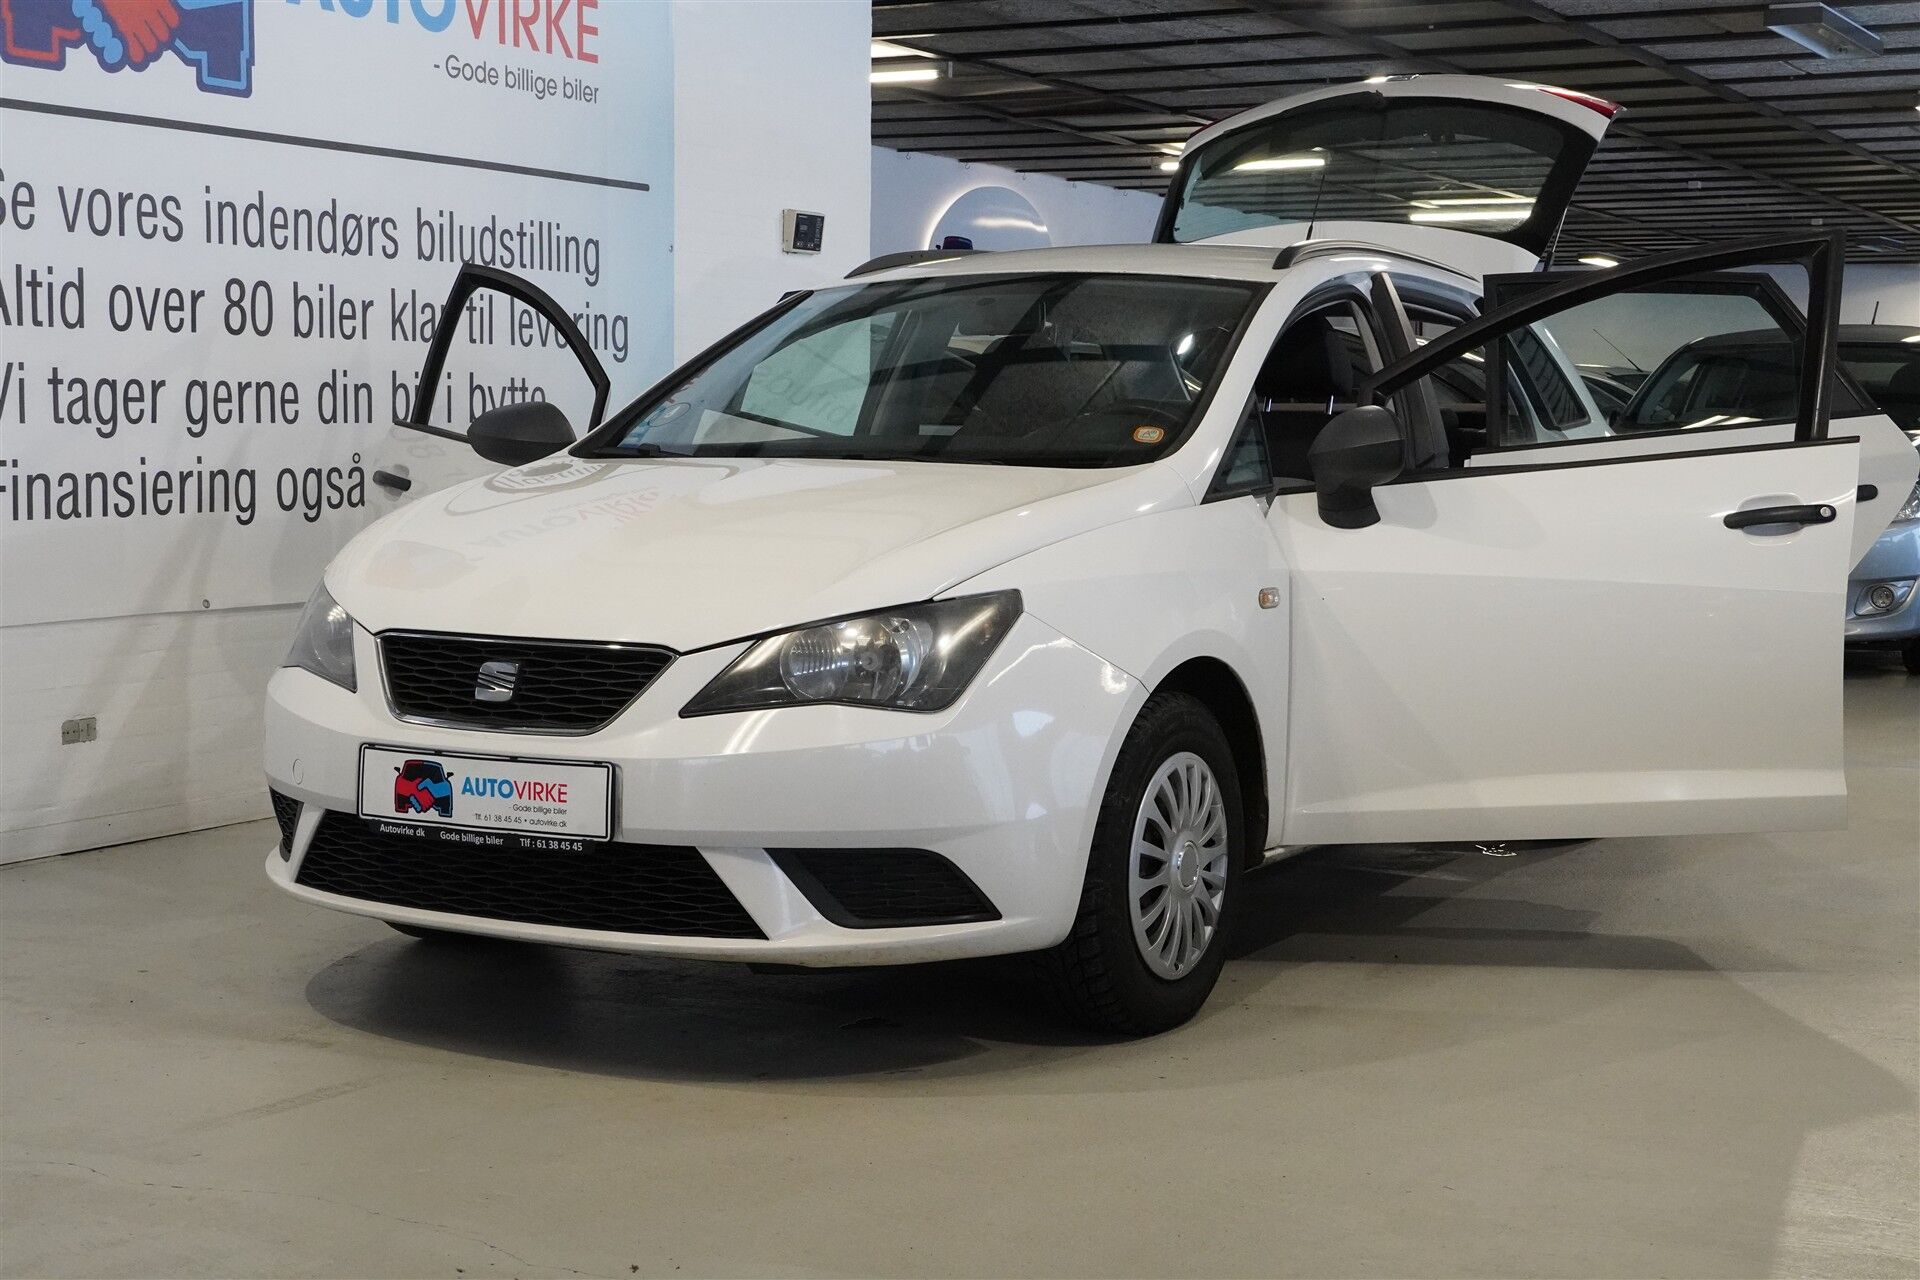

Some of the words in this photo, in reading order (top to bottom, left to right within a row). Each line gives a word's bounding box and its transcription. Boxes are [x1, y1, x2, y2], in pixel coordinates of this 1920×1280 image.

[286, 0, 598, 64] VIRKE
[445, 54, 499, 86] Gode
[504, 68, 558, 100] billige
[562, 76, 599, 105] biler
[57, 185, 184, 242] vores
[205, 185, 399, 260] indendørs
[417, 206, 600, 287] biludstilling
[108, 284, 206, 334] over
[223, 277, 273, 337] 80
[293, 281, 374, 340] biler
[391, 288, 445, 343] kla
[466, 296, 493, 345] til
[47, 367, 166, 439] tager
[185, 379, 300, 439] gerne
[318, 369, 373, 424] din
[447, 372, 452, 423] i
[276, 452, 366, 523] også
[461, 776, 568, 804] AUTOVIRKE
[512, 803, 532, 813] Gode
[533, 805, 552, 816] billige
[553, 807, 568, 816] biler
[440, 830, 460, 842] Gode
[462, 832, 484, 846] billige
[485, 834, 504, 846] biler
[484, 814, 492, 822] 61
[494, 814, 503, 823] 38
[504, 815, 512, 824] 45
[513, 816, 522, 825] 45
[536, 839, 547, 849] 61
[548, 840, 559, 850] 38
[560, 841, 571, 851] 45
[572, 842, 583, 852] 45
